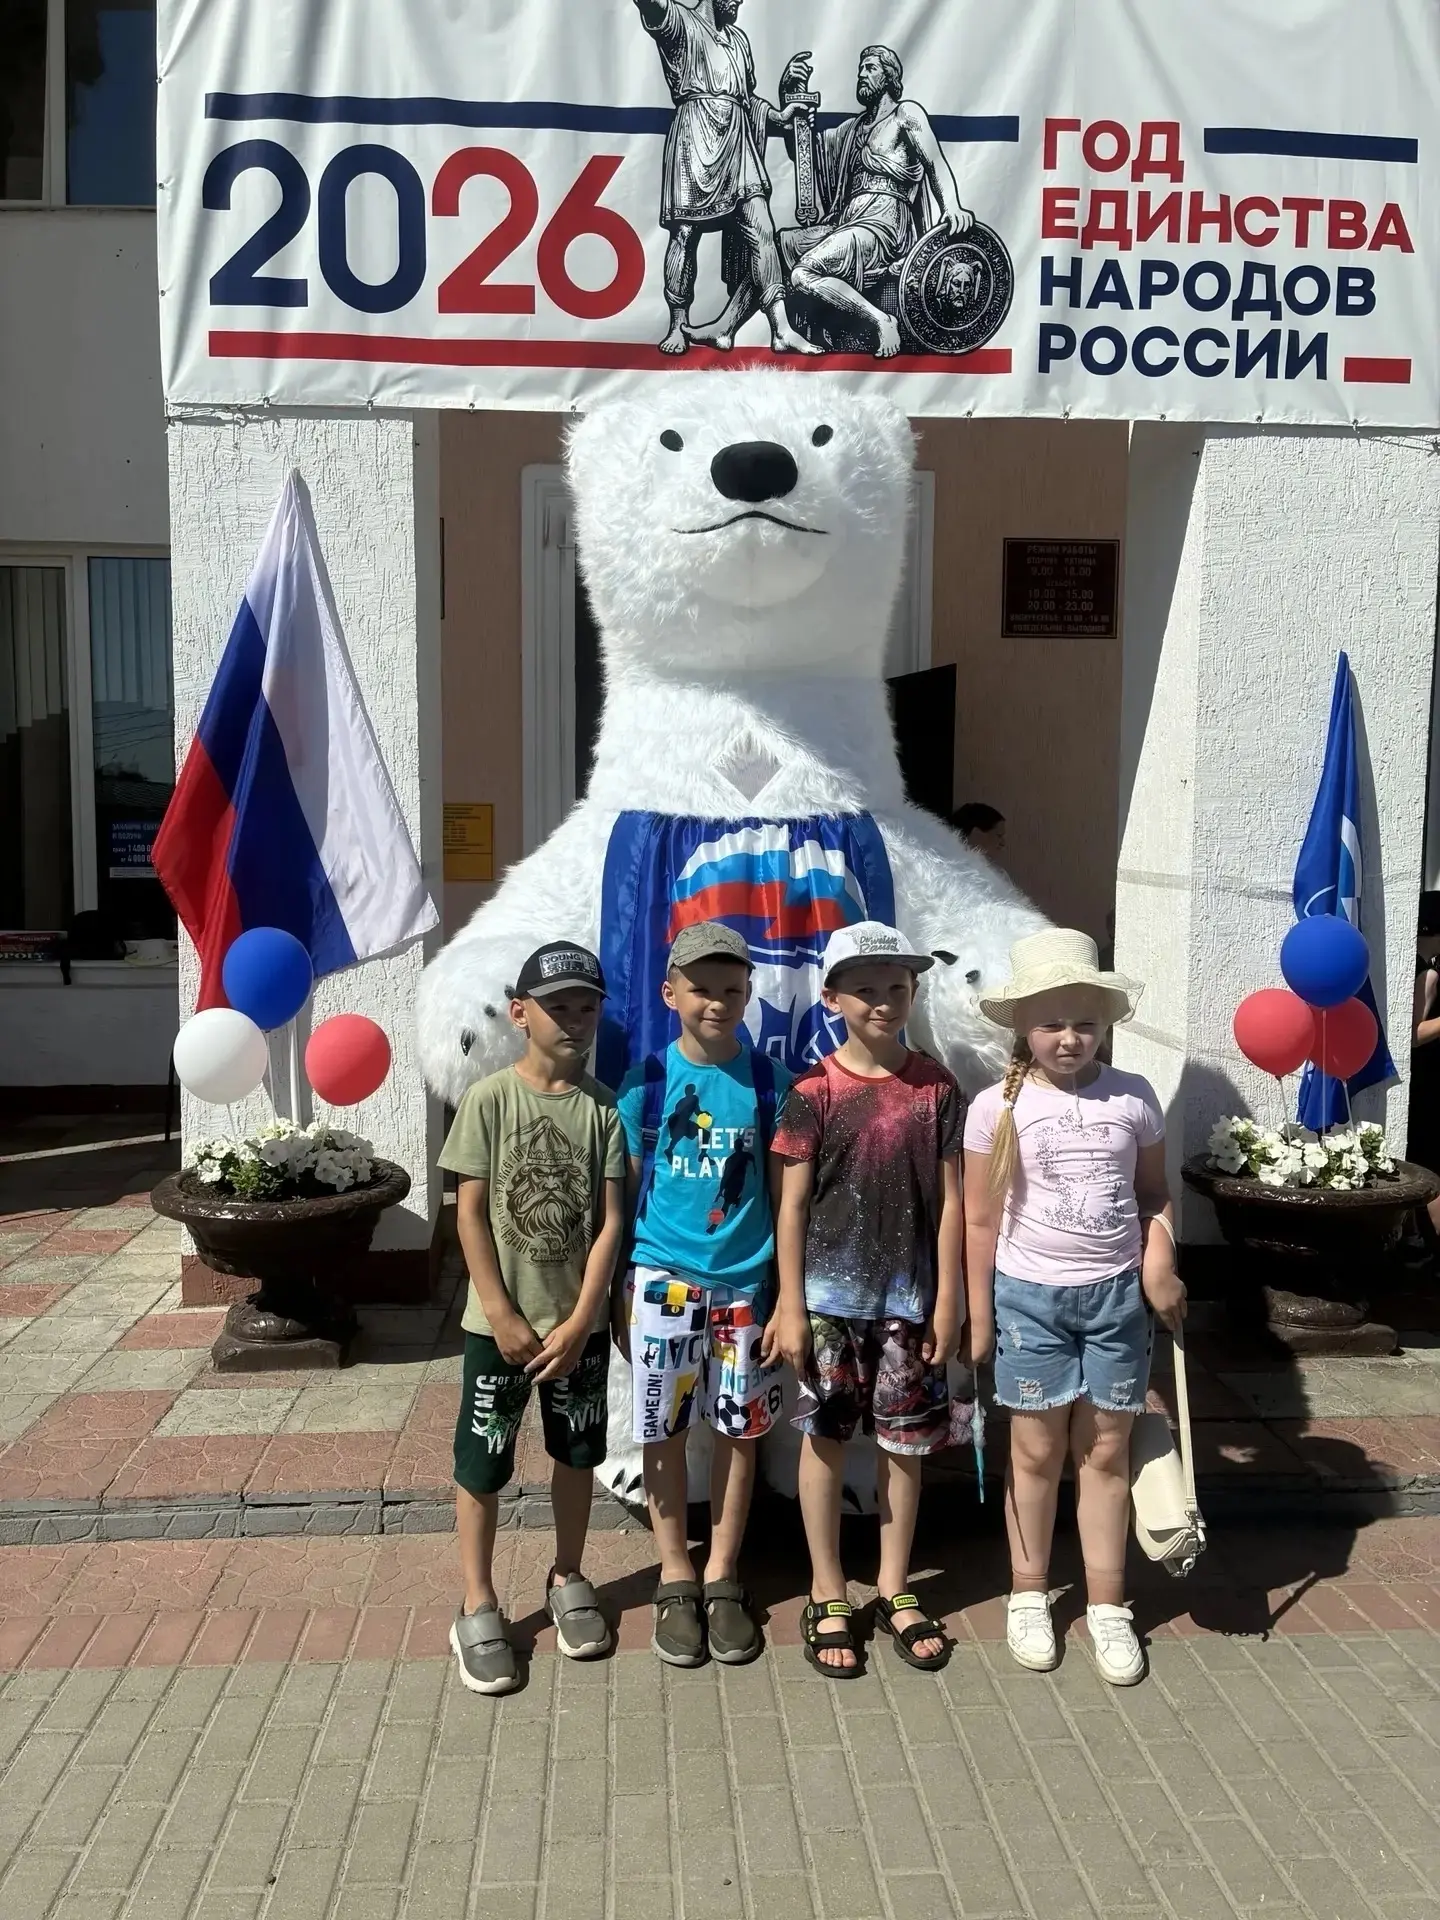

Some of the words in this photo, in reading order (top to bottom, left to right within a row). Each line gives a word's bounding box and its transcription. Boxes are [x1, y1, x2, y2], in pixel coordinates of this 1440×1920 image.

[1042, 117, 1185, 184] ГОД
[201, 138, 646, 320] 2026
[1039, 187, 1415, 254] ЕДИНСТВА
[1039, 256, 1377, 322] НАРОДОВ
[1038, 322, 1329, 381] РОССИИ
[1026, 545, 1060, 555] РЕЖИМ
[1061, 545, 1097, 555] РАБОТЫ
[1065, 601, 1094, 612] 23.00
[1066, 590, 1094, 600] 15.00
[698, 1128, 756, 1152] LET'S
[671, 1155, 728, 1178] PLAY
[647, 1374, 664, 1397] ON!
[471, 1375, 497, 1437] KING
[497, 1376, 510, 1385] OF
[644, 1399, 661, 1438] GAME
